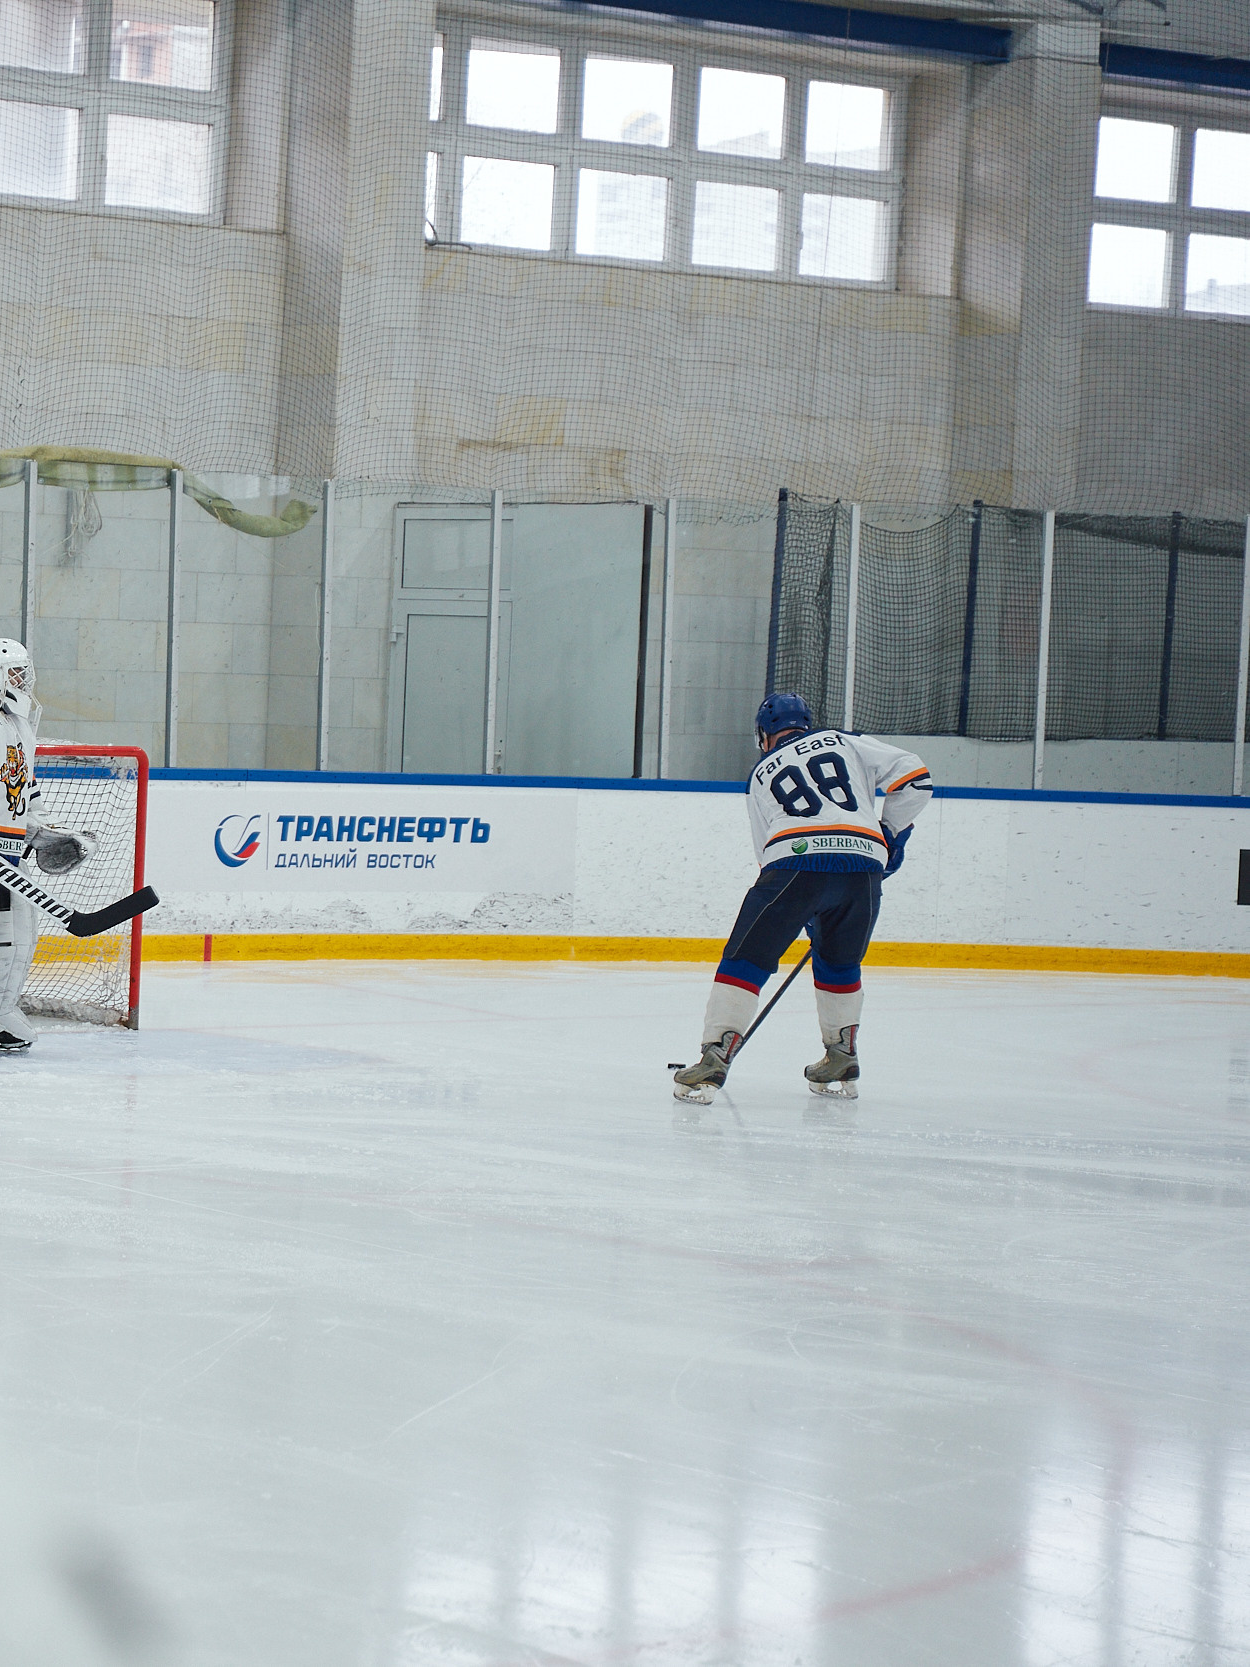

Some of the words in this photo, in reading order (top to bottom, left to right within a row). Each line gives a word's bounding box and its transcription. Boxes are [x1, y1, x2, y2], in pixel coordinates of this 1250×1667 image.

[755, 755, 783, 786] Far
[794, 733, 846, 756] East
[770, 751, 859, 818] 88
[276, 815, 491, 844] ТРАНСНЕФТЬ
[274, 848, 357, 869] ДАЛЬНИЙ
[366, 853, 438, 869] ВОСТОК
[812, 837, 874, 853] SBERBANK
